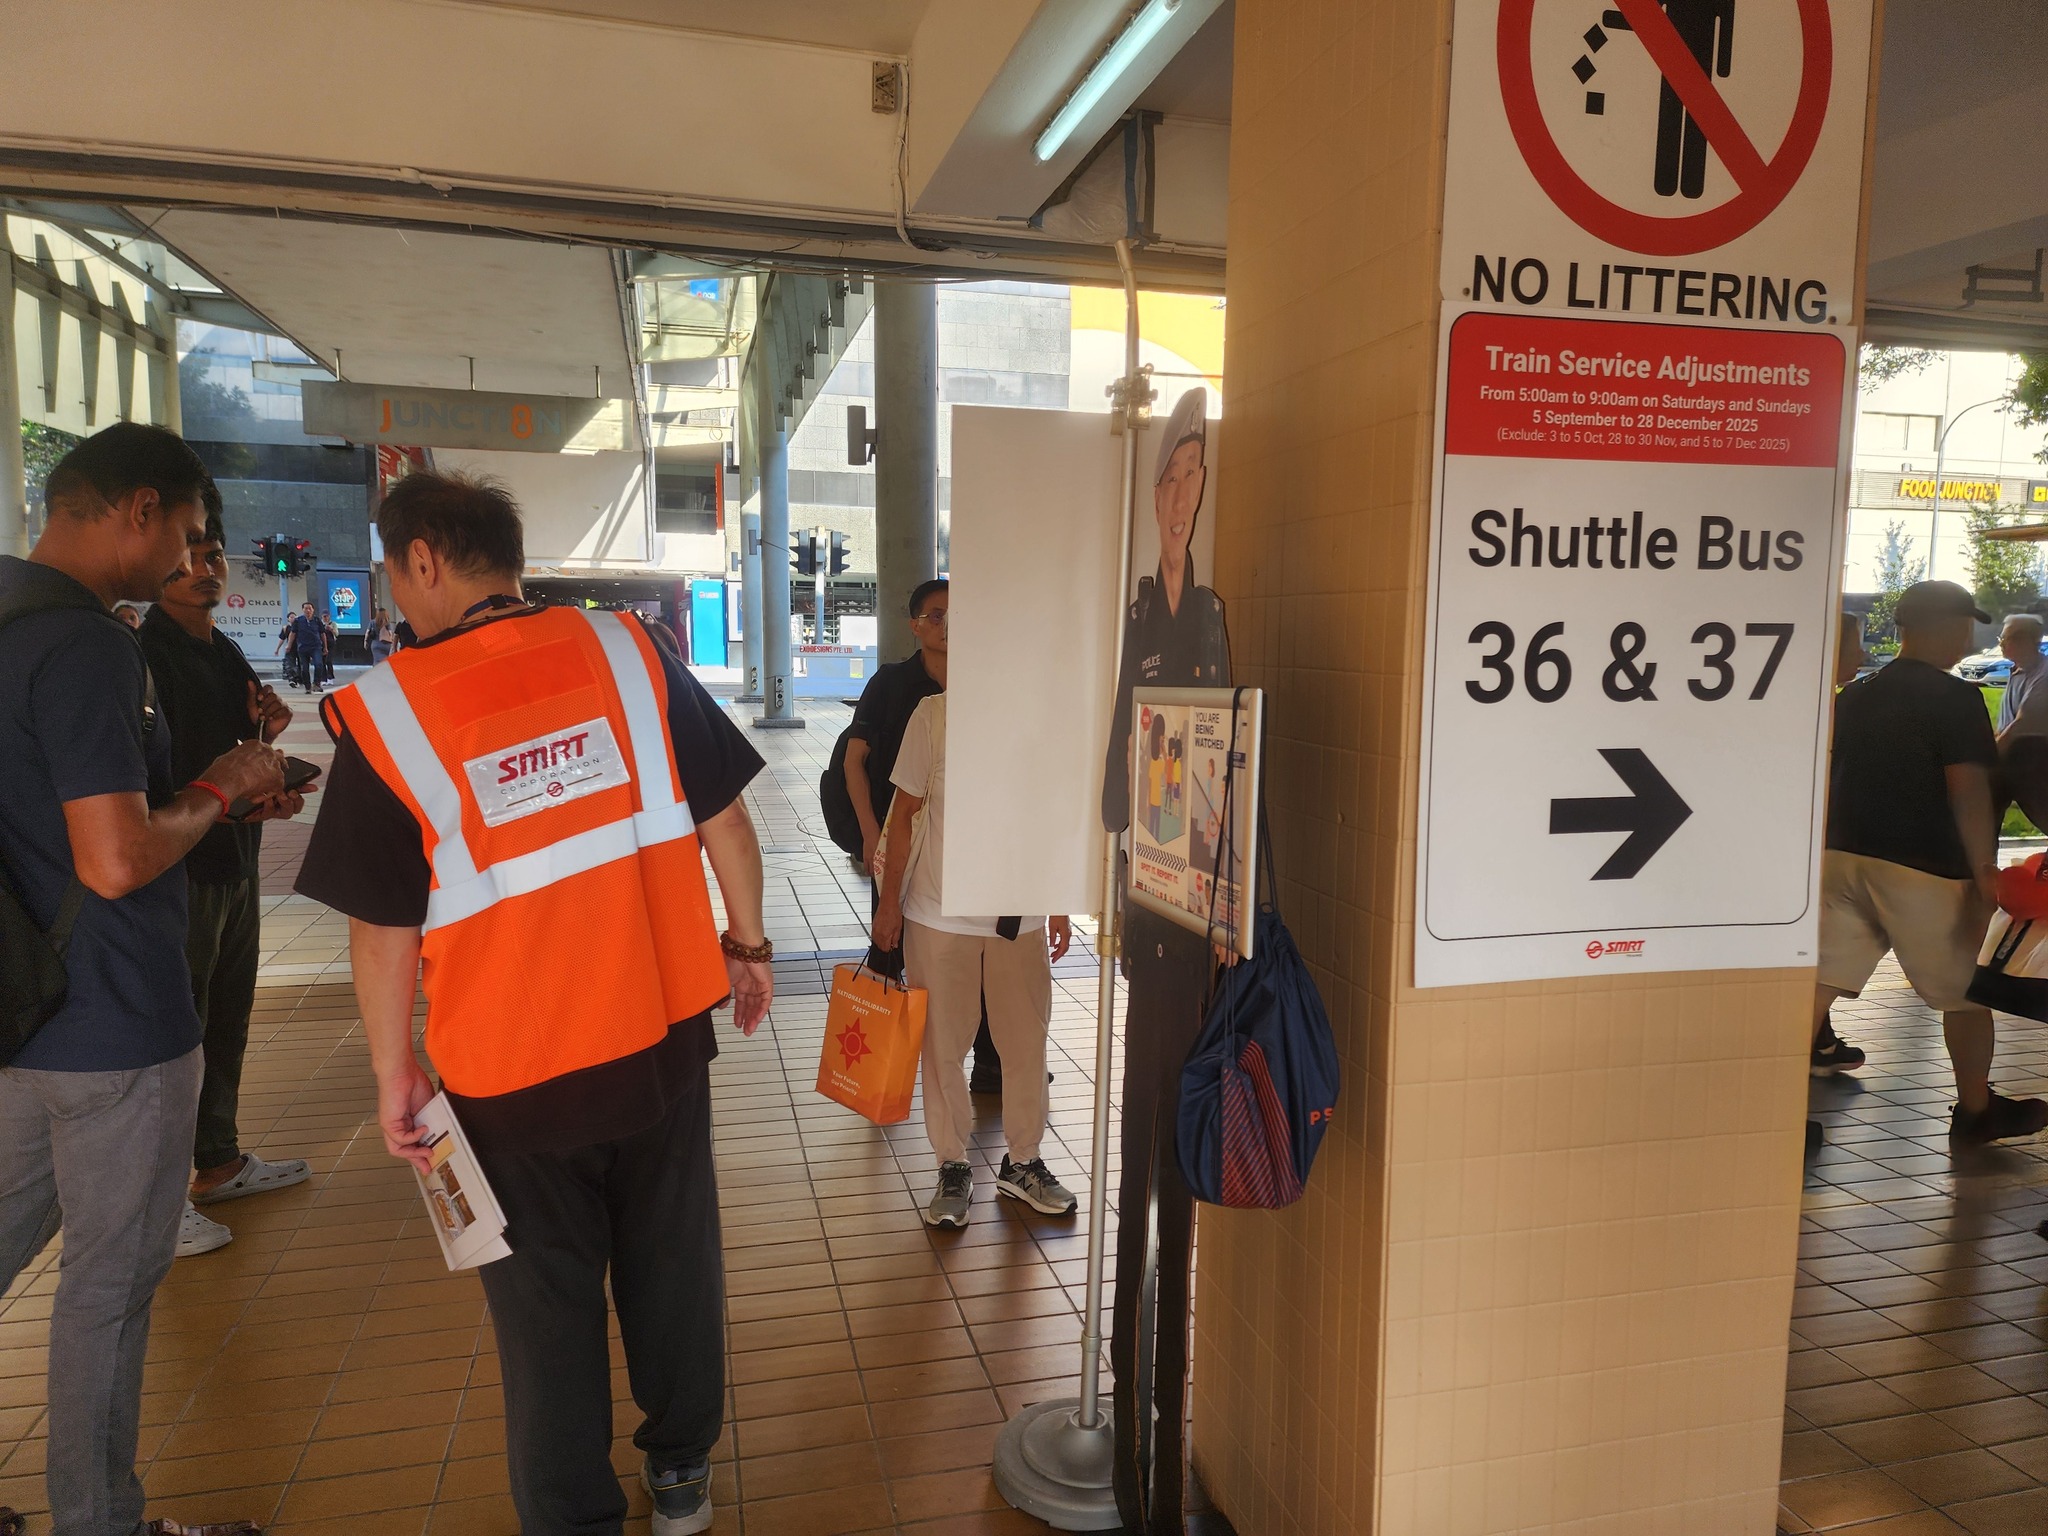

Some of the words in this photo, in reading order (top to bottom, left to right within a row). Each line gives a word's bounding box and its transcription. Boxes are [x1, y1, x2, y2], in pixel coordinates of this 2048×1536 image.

[1471, 255, 1549, 305] NO
[1567, 263, 1829, 325] LITTERING
[1485, 345, 1551, 374] Train
[1558, 350, 1651, 379] Service
[1657, 355, 1811, 388] Adjustments
[1480, 385, 1515, 401] From
[1519, 387, 1568, 404] 5:00am
[1572, 391, 1586, 405] to
[1589, 391, 1638, 407] 9:00am
[1642, 396, 1658, 408] on
[1662, 394, 1725, 413] Saturdays
[1728, 398, 1753, 412] and
[1756, 398, 1811, 417] Sundays
[1532, 410, 1541, 424] 5
[1545, 410, 1617, 428] September
[1620, 413, 1634, 427] to
[1637, 414, 1653, 428] 28
[1657, 415, 1722, 431] December
[1725, 418, 1759, 432] 2025
[1497, 426, 1547, 442] (Exclude:
[1549, 430, 1557, 442] 3
[1560, 430, 1571, 443] to
[1574, 431, 1581, 443] 5
[1583, 432, 1605, 445] Oct,
[1608, 432, 1622, 444] 28
[1624, 433, 1636, 445] to
[1638, 434, 1652, 446] 30
[1654, 434, 1678, 448] Nov,
[1680, 436, 1700, 448] and
[1703, 436, 1710, 448] 5
[1712, 437, 1723, 448] to
[1726, 437, 1733, 448] 7
[1735, 438, 1756, 449] Dec
[1759, 438, 1790, 452] 2025)
[1900, 479, 1937, 498] FOOD
[1468, 508, 1678, 570] Shuttle
[1697, 515, 1805, 572] Bus
[248, 599, 282, 607] CHAGE
[231, 616, 241, 625] IN
[1465, 621, 1573, 704] 36
[1602, 621, 1659, 703] &
[1687, 622, 1795, 703] 37
[1195, 711, 1207, 723] YOU
[1208, 712, 1220, 724] ARE
[1195, 723, 1214, 736] BEING
[1195, 737, 1225, 750] WATCHED
[498, 732, 589, 785] SMRT
[501, 757, 601, 795] CORPORATION
[1605, 940, 1645, 952] SMRT
[837, 988, 862, 1004] NATIONAL
[861, 999, 892, 1016] SOLIDARITY
[852, 1004, 869, 1016] PARTY
